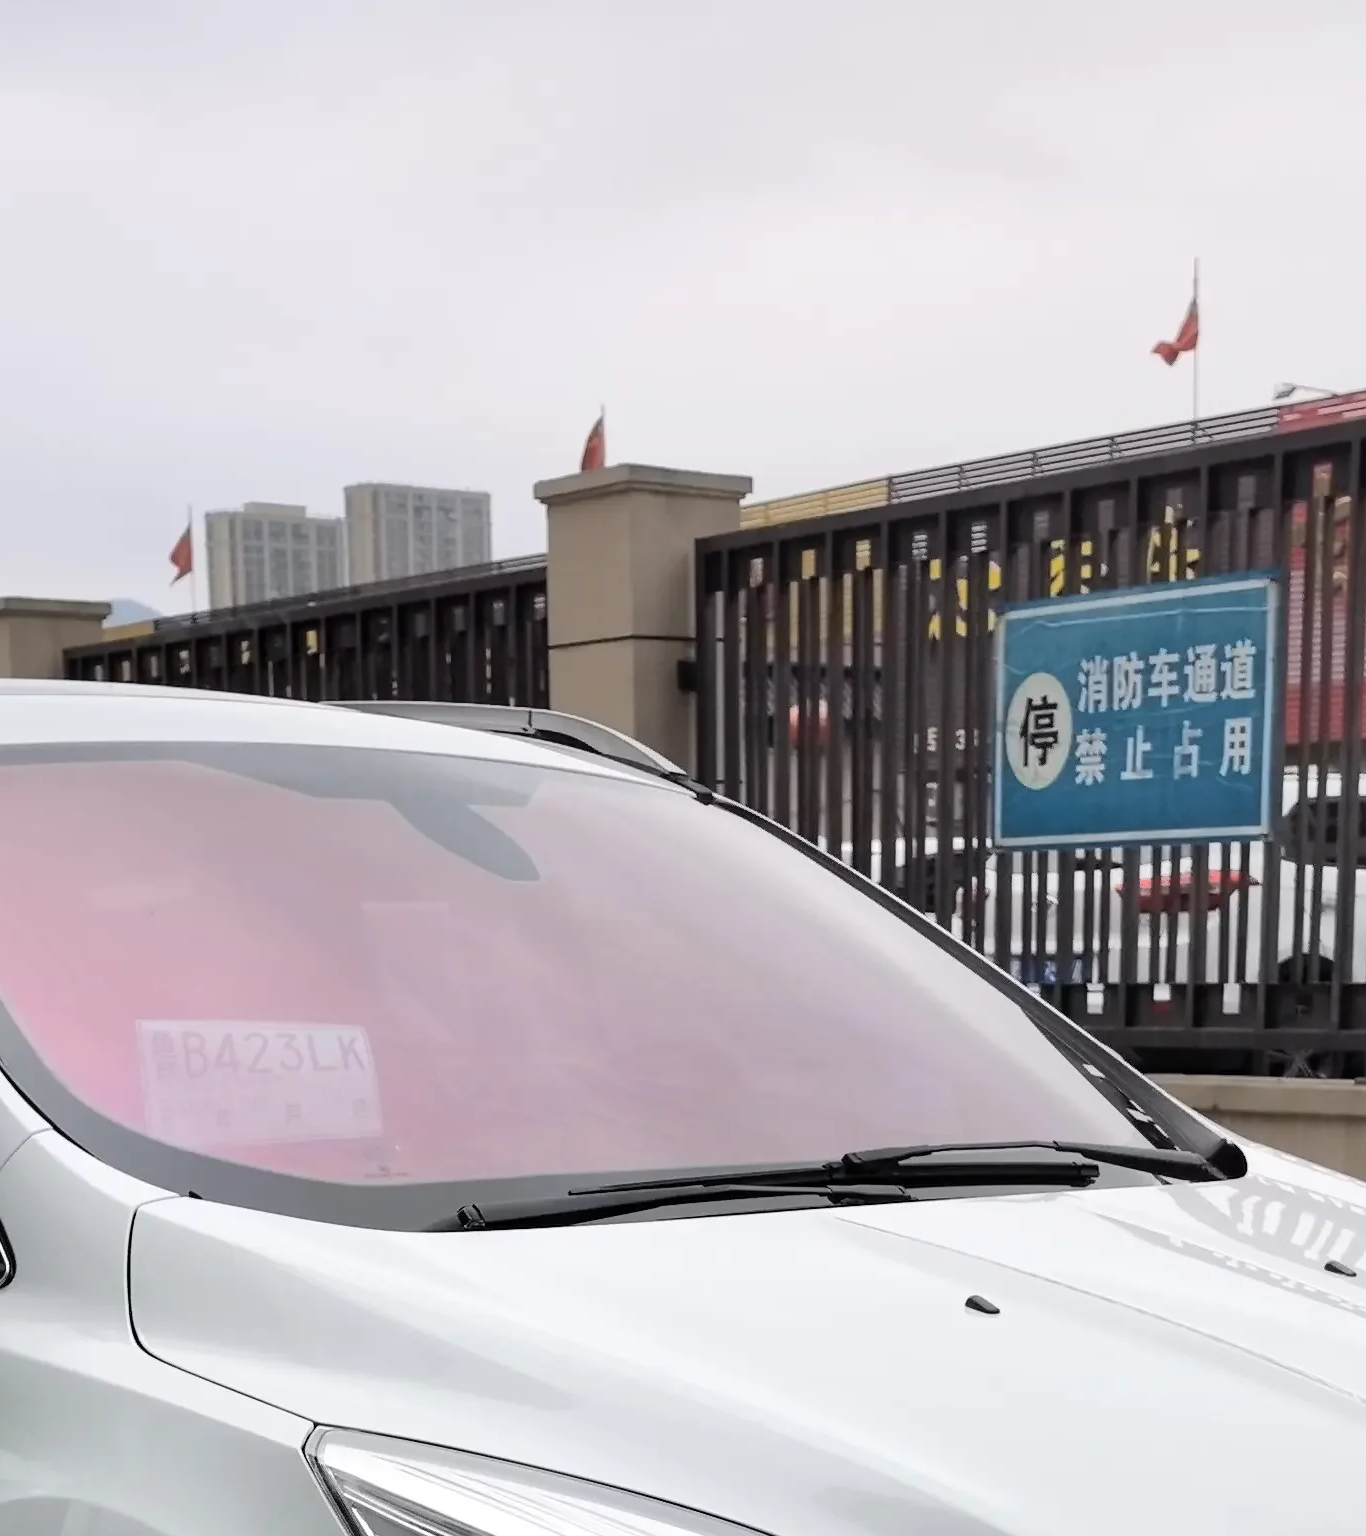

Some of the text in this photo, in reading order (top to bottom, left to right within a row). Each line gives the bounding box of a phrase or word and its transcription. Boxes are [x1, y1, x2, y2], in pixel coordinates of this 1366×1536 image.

[1077, 638, 1258, 714] 消防车通道
[1019, 695, 1059, 768] 停
[1074, 717, 1253, 786] 禁止占用
